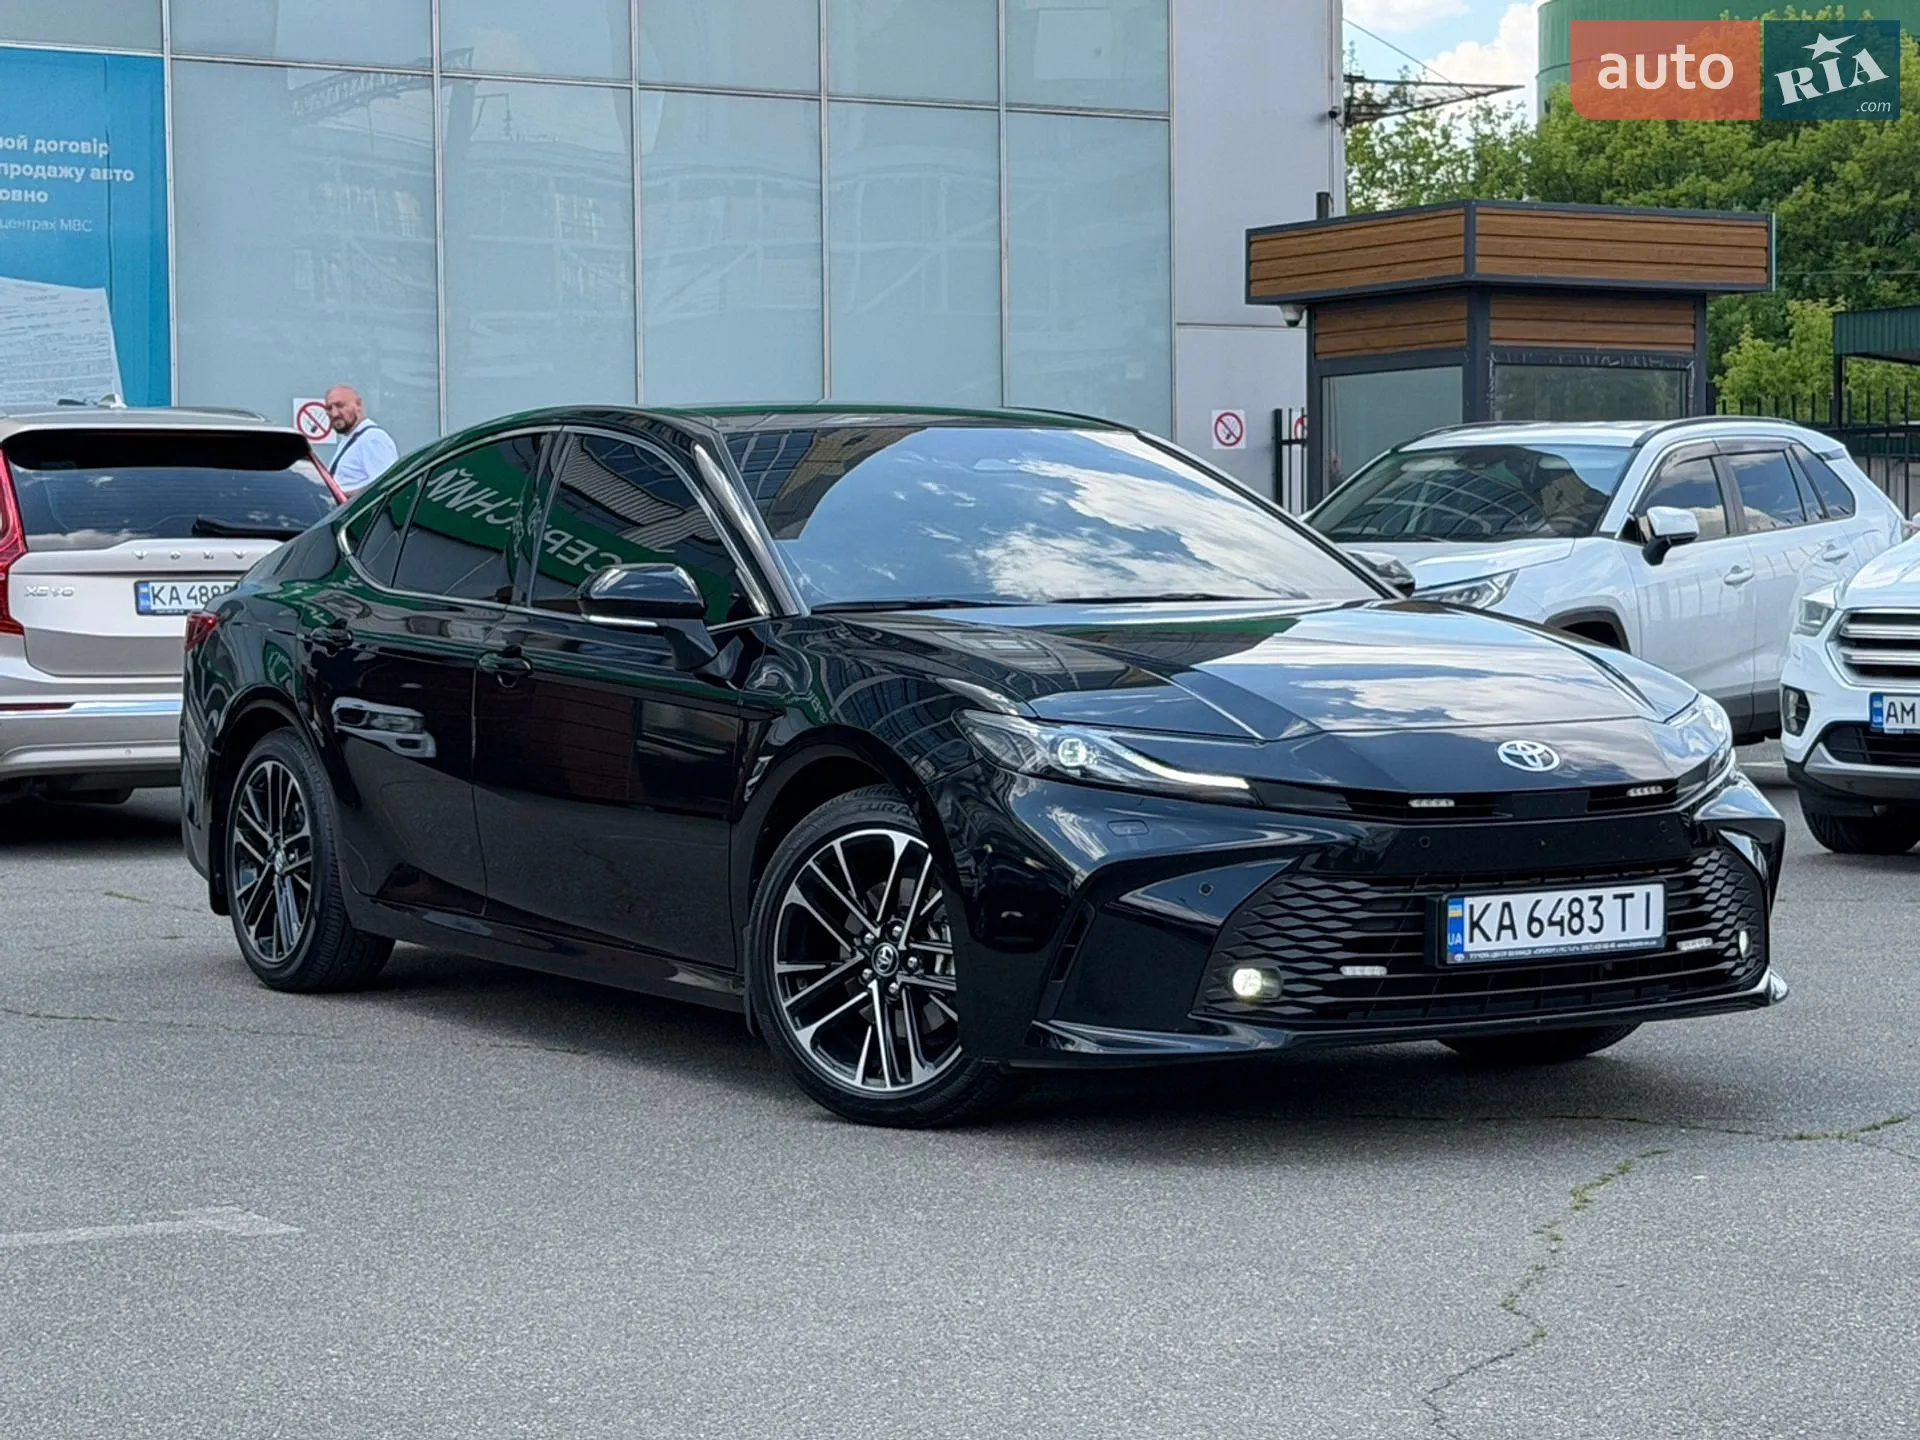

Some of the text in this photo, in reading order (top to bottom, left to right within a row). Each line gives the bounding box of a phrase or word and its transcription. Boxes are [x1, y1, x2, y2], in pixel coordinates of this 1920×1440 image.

[34, 138, 109, 158] договір
[90, 167, 135, 182] авто
[60, 219, 93, 232] МВС
[151, 584, 183, 606] KA
[1885, 701, 1916, 725] AM
[1468, 891, 1651, 944] KA 6483 TI
